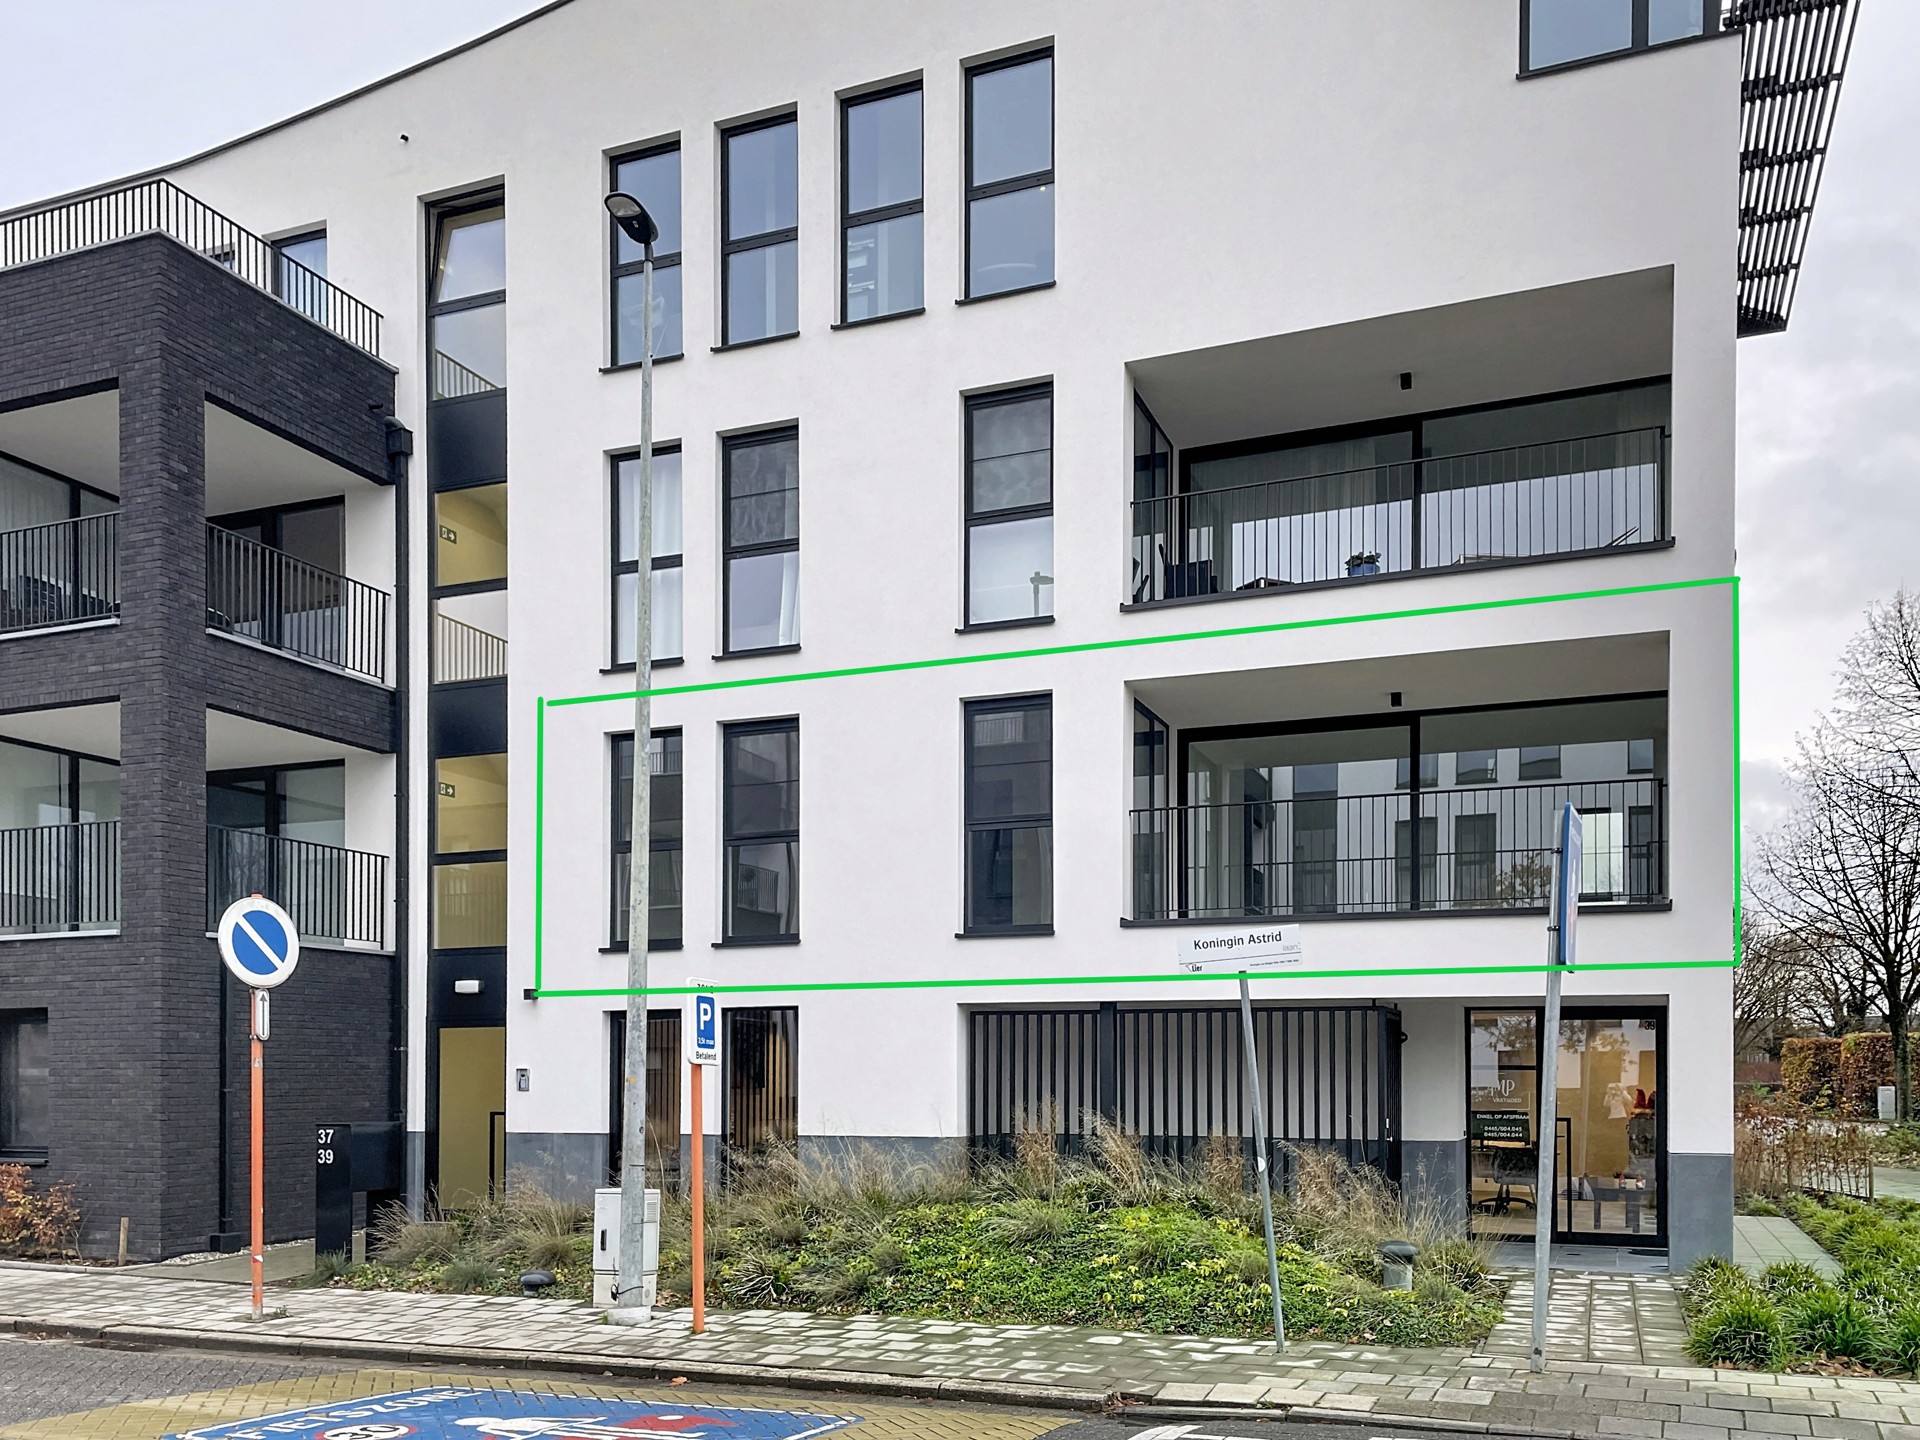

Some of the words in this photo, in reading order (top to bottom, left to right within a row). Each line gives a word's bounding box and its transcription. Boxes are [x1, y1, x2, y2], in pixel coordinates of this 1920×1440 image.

[1193, 936, 1244, 950] Koningin
[1248, 931, 1282, 944] Astrid
[700, 1003, 712, 1030] P
[1644, 1020, 1656, 1031] 39
[695, 1051, 717, 1060] Betalend
[317, 1129, 334, 1144] 37
[317, 1149, 334, 1164] 39
[224, 1389, 484, 1440] FIETSZONE
